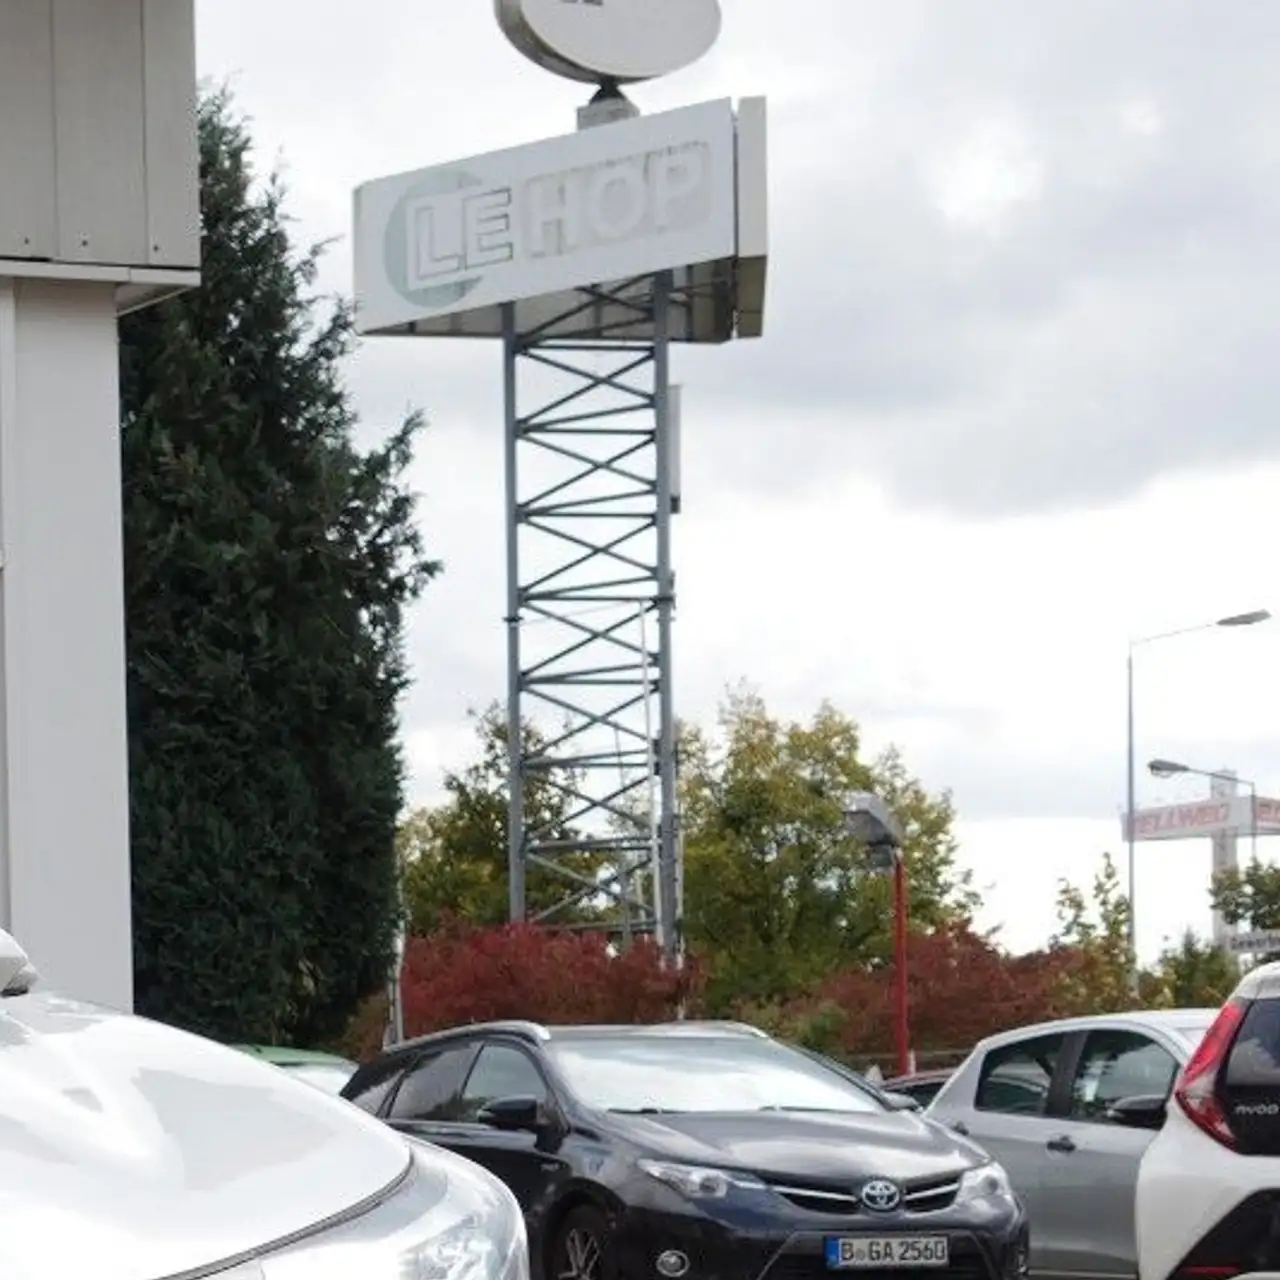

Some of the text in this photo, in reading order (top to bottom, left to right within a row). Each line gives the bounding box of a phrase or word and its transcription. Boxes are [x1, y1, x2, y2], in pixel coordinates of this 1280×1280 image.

[841, 1240, 947, 1261] B GA 2560
